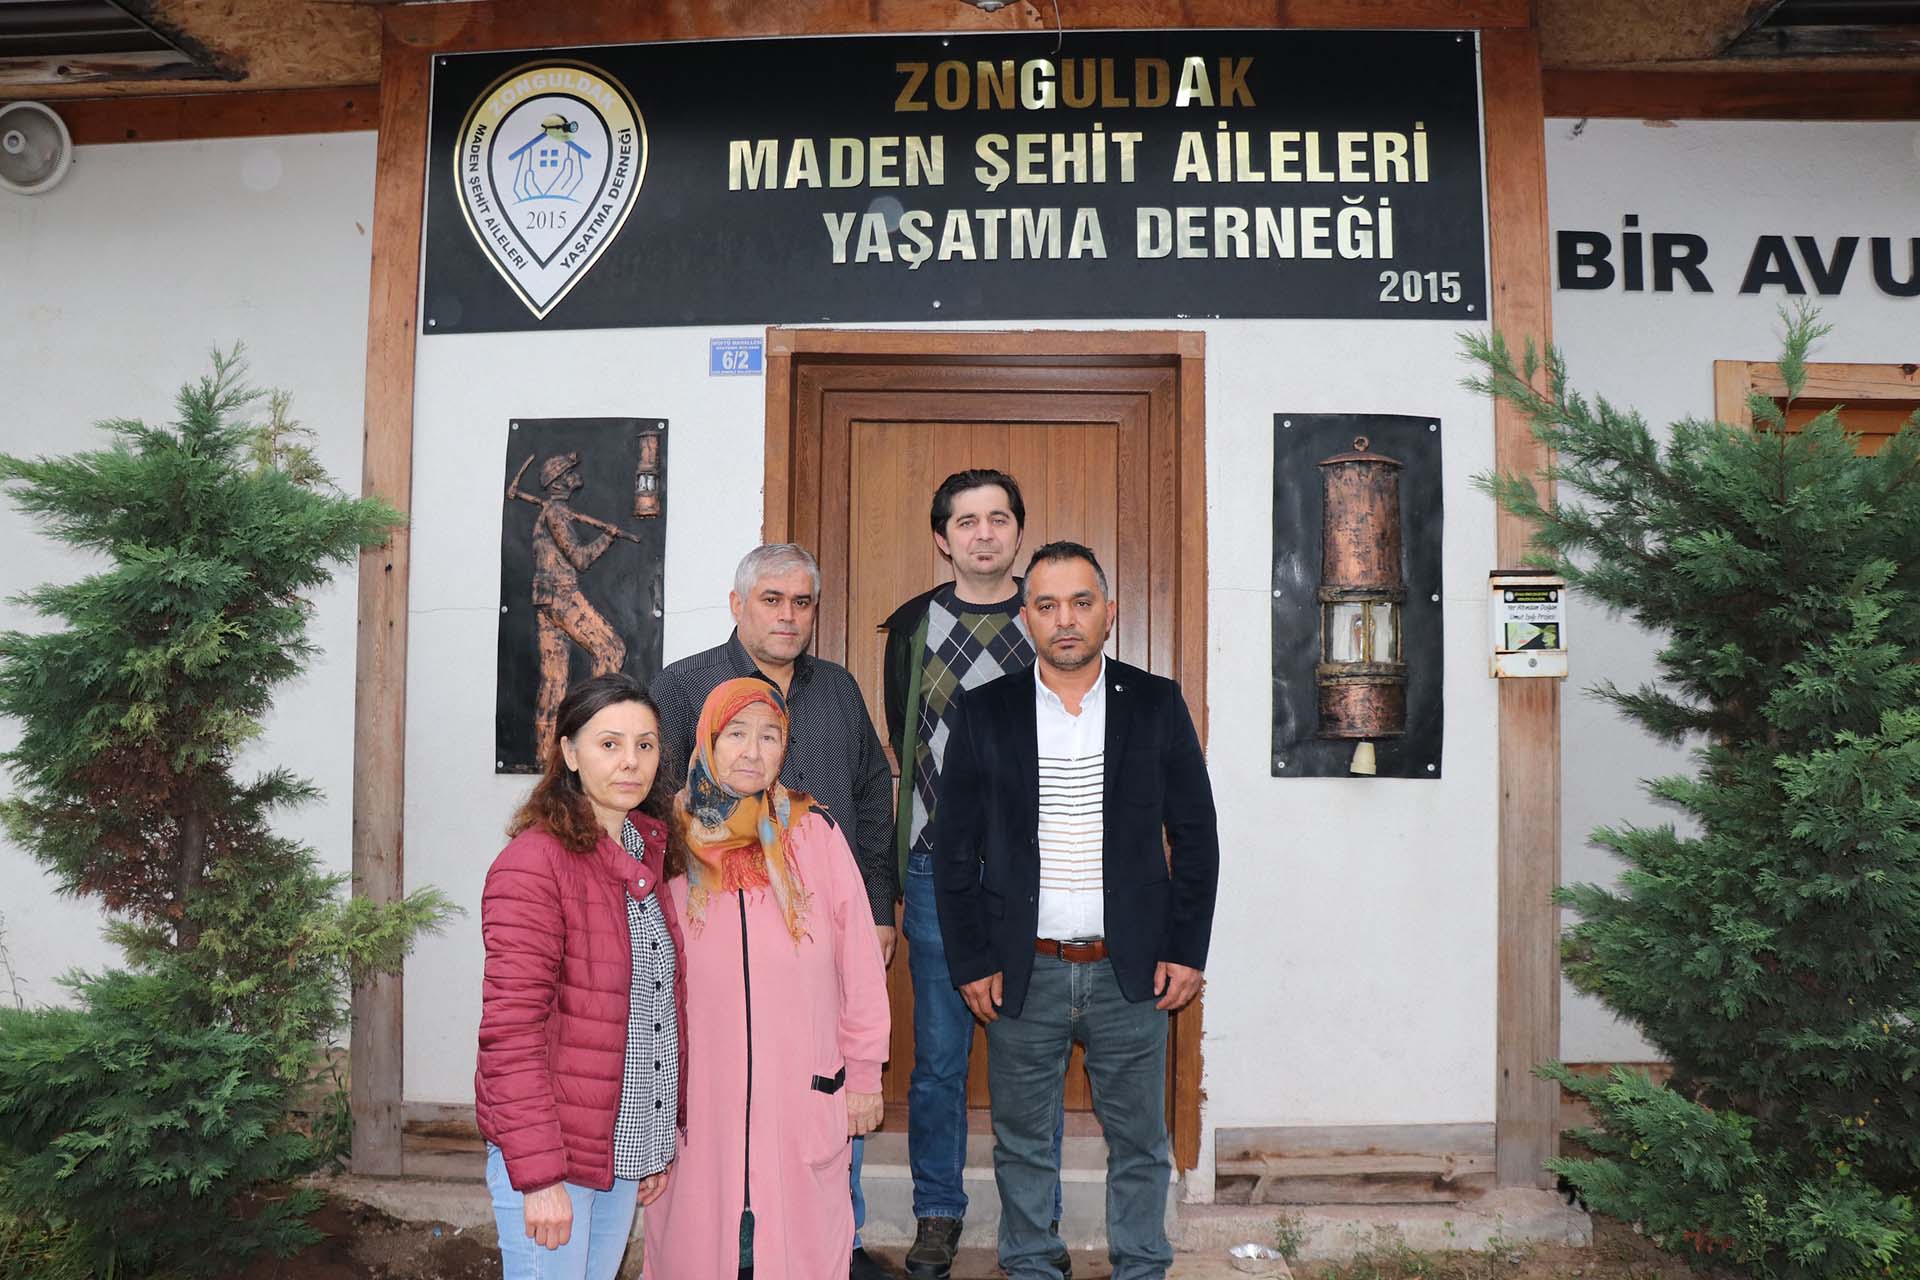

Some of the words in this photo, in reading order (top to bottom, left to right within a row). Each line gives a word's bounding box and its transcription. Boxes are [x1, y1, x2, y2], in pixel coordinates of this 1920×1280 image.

[488, 72, 617, 116] ZONGULDAK
[894, 56, 1256, 112] ZONGULDAK
[469, 123, 487, 173] MADEN
[729, 135, 945, 190] MADEN
[974, 122, 1143, 192] ŞEHİT
[1172, 120, 1429, 183] AİLELERİ
[468, 176, 490, 214] ŞEHİT
[526, 210, 567, 230] 2015
[560, 203, 614, 270] YAŞATMA
[608, 127, 632, 200] DERNEĞİ
[485, 218, 529, 270] AİLELERİ
[822, 208, 1108, 270] YAŞATMA
[1136, 195, 1394, 259] DERNEĞİ
[1556, 214, 1714, 293] BİR
[1379, 270, 1462, 303] 2015
[722, 350, 749, 370] 6/2
